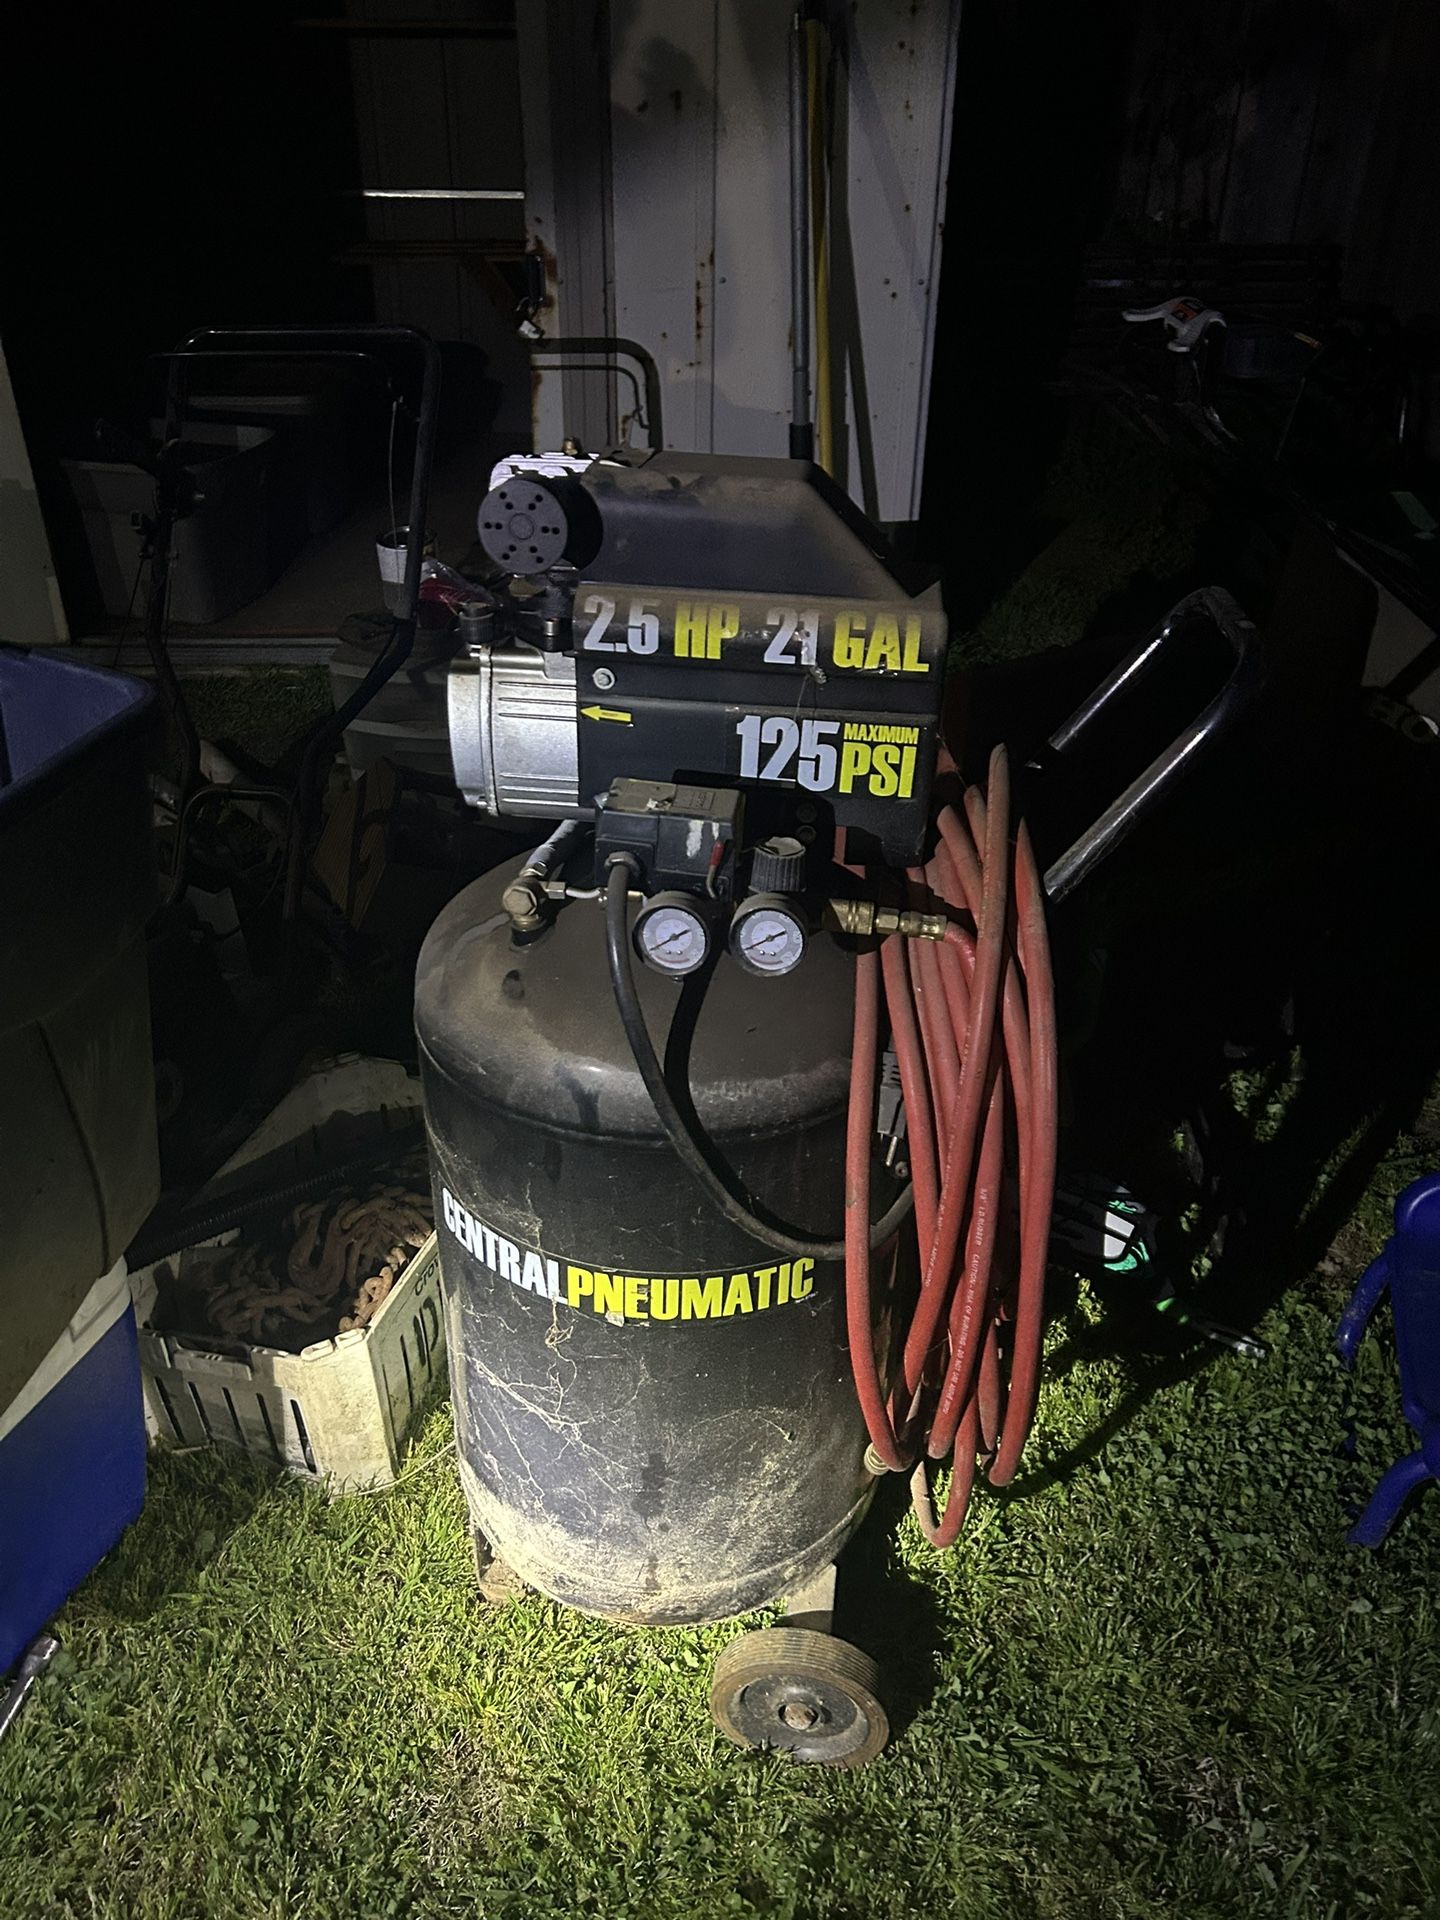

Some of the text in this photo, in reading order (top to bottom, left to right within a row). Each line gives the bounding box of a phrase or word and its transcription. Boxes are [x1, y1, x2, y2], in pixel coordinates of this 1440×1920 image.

[583, 595, 930, 672] 2.5 HP 21 GAL
[736, 715, 918, 798] 125 PSI
[843, 722, 919, 745] MAXIMUM
[441, 1187, 815, 1321] CENTRAL PNEUMATIC
